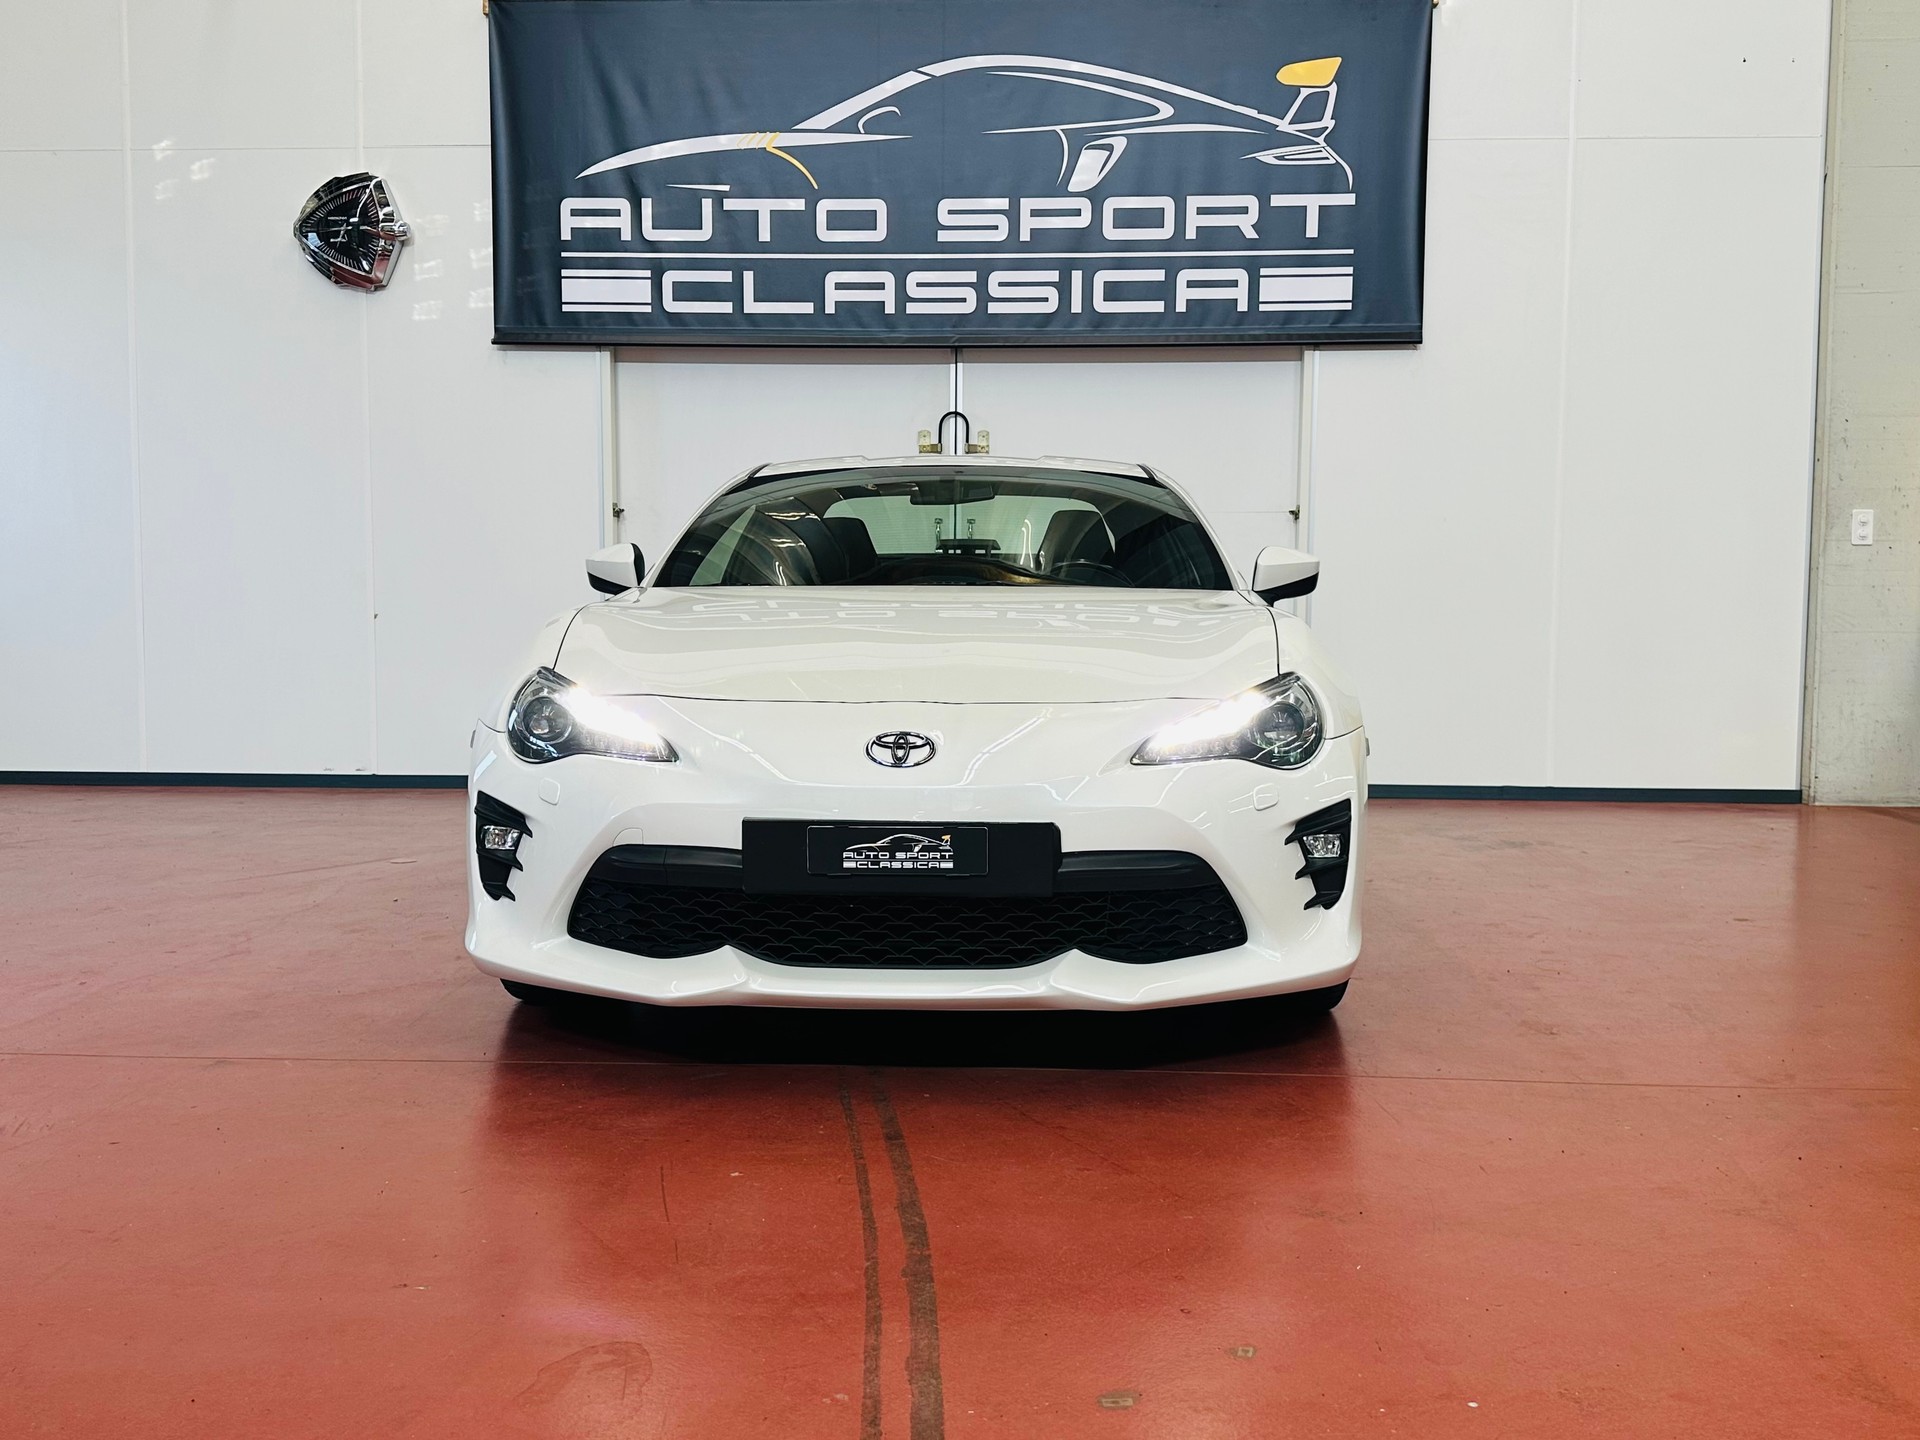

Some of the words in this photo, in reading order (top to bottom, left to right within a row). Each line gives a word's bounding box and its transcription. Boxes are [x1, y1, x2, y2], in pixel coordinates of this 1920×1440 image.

[560, 197, 888, 243] AUTO
[937, 193, 1356, 242] SPORT
[661, 268, 1249, 314] CLASSICA
[842, 851, 890, 859] AUTO
[895, 851, 954, 859] SPORT
[856, 861, 940, 869] CLASSICA
